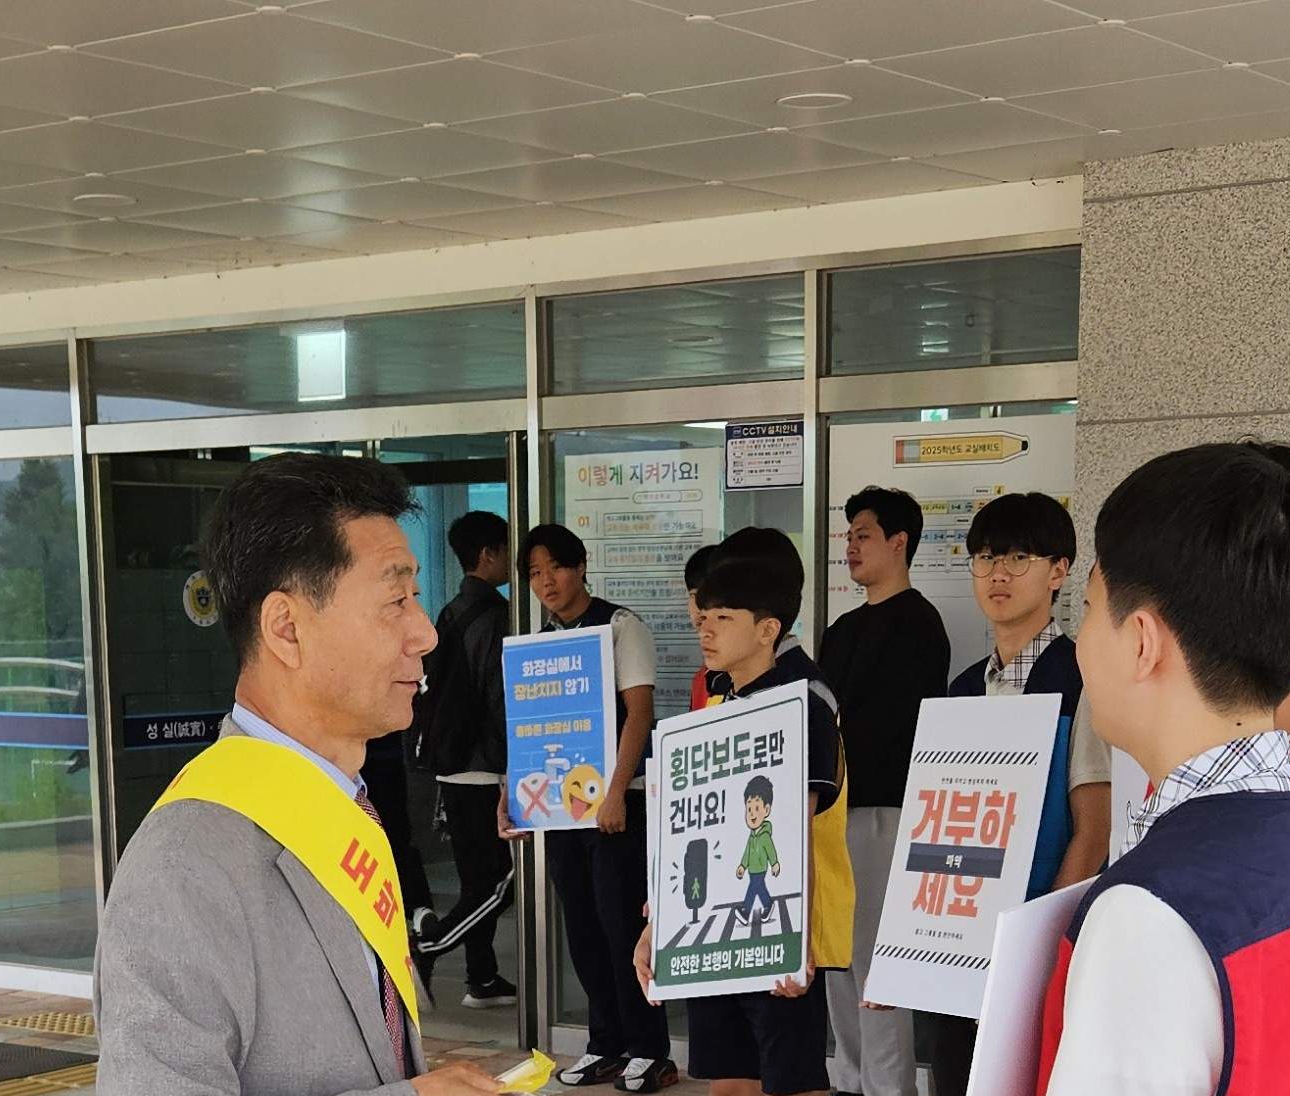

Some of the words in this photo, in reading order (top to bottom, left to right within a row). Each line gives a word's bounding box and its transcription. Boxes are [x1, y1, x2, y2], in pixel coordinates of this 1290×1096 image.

[742, 426, 767, 437] CCTV
[578, 464, 623, 487] 이렇게
[629, 461, 699, 485] 지켜가요!
[577, 515, 589, 528] 01
[522, 655, 582, 677] 화장실에서
[514, 680, 562, 701] 장난치지
[565, 677, 589, 695] 않기
[146, 722, 158, 740] 성
[670, 729, 785, 791] 횡단보도로만
[669, 789, 726, 835] 건너요!
[910, 789, 1017, 849] 거부하
[946, 854, 963, 869] 마약
[912, 871, 984, 918] 세요
[670, 953, 700, 976] 안전한
[702, 950, 732, 972] 보행의
[734, 943, 785, 968] 기본입니다
